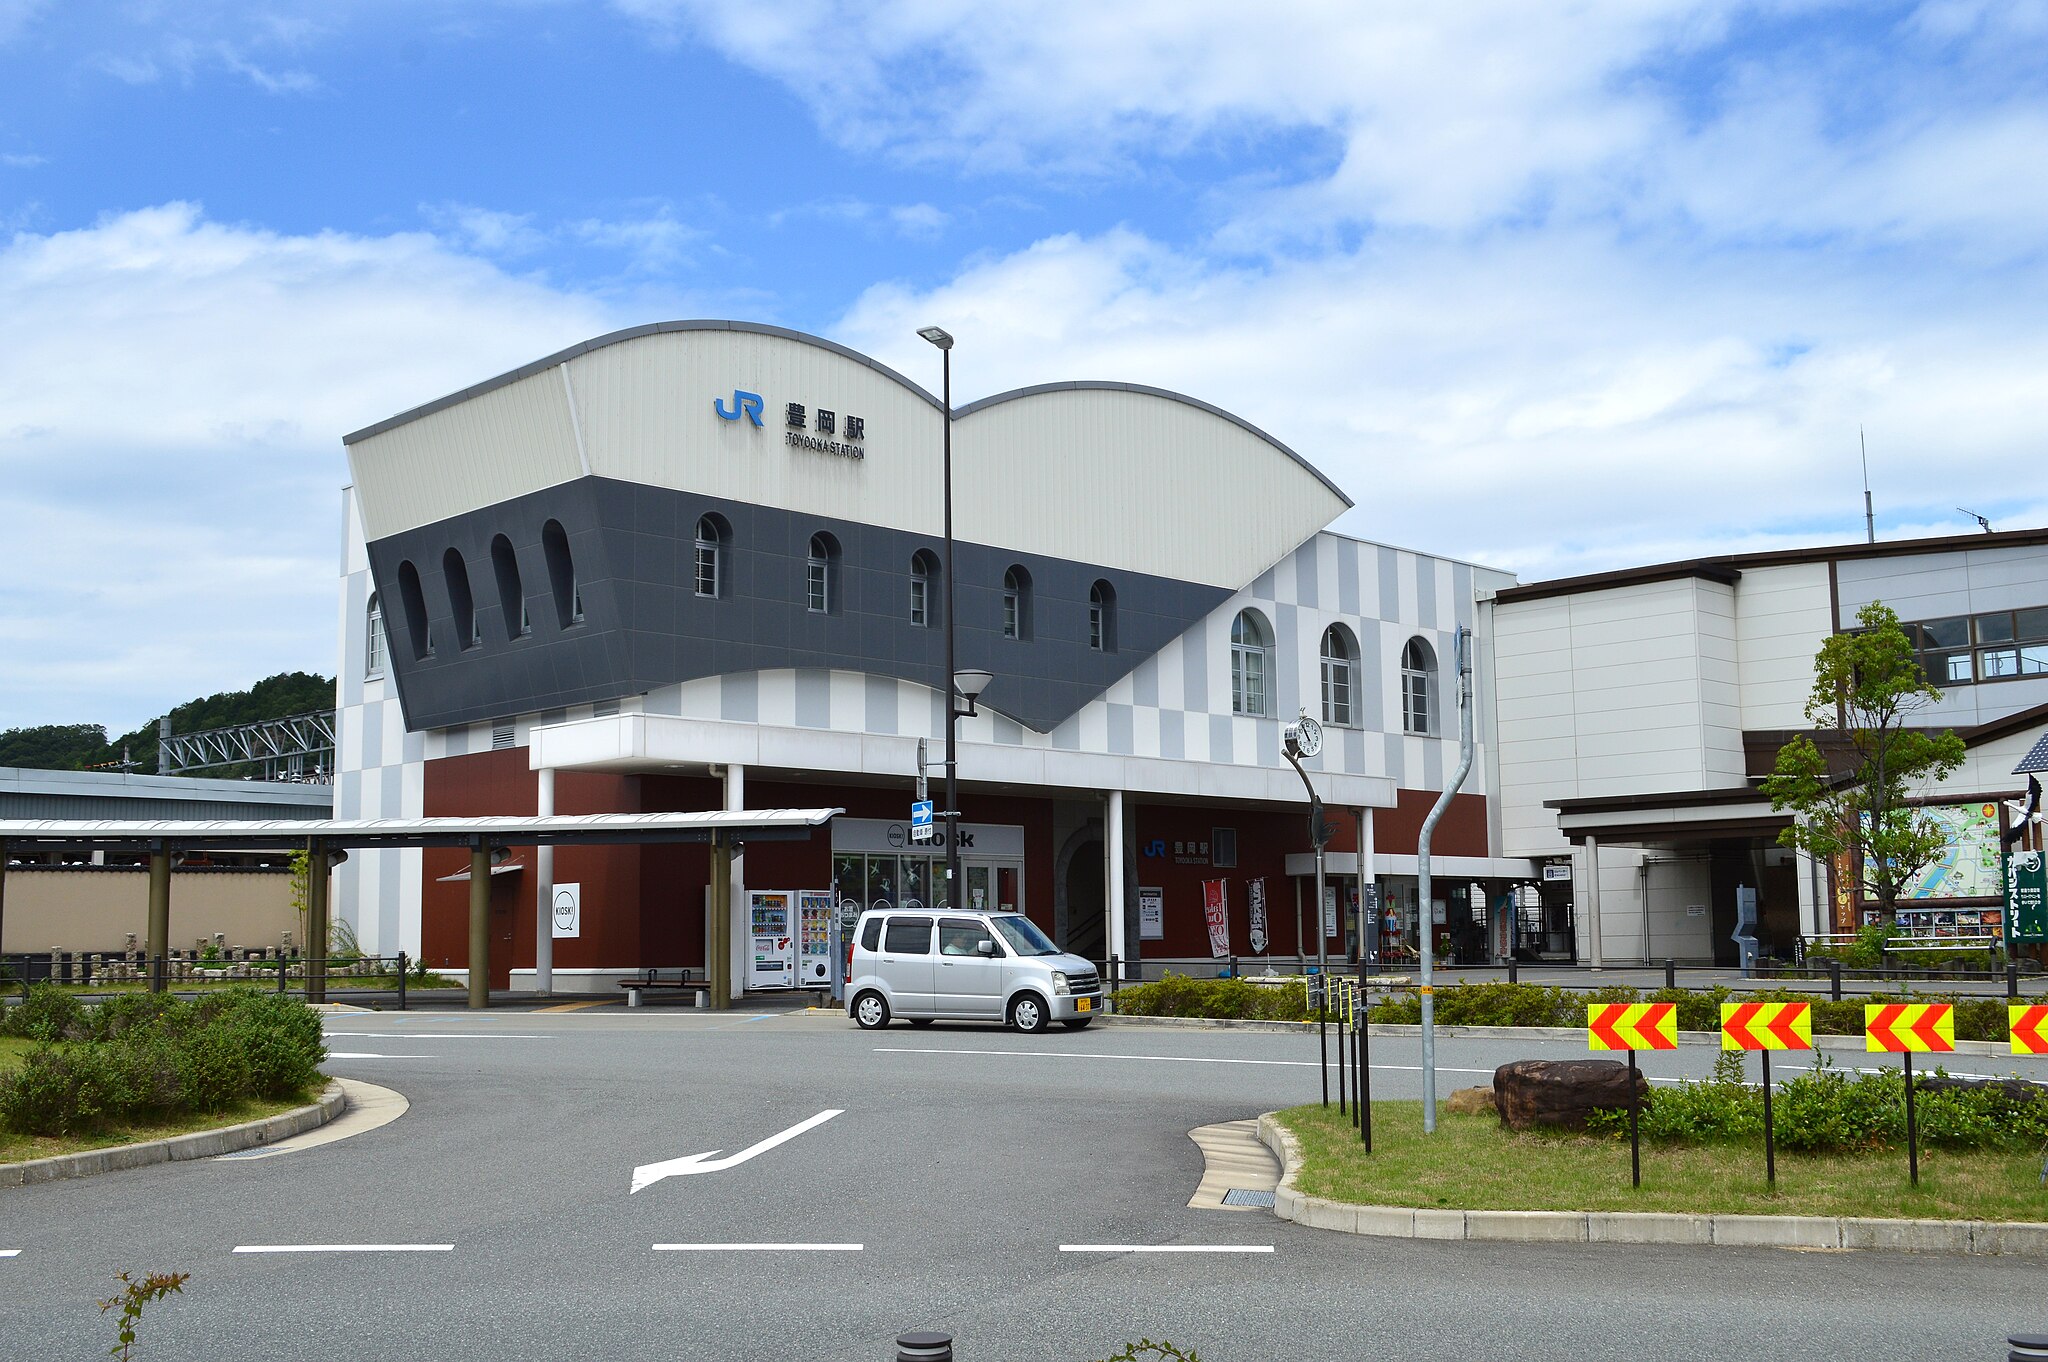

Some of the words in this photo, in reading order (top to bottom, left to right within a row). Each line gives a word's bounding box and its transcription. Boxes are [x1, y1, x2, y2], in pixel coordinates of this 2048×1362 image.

[715, 389, 764, 427] JR
[787, 402, 865, 441] 豊岡駅
[787, 431, 829, 454] TOYOOKA
[829, 441, 865, 460] STATION
[1174, 841, 1209, 854] 豊岡駅
